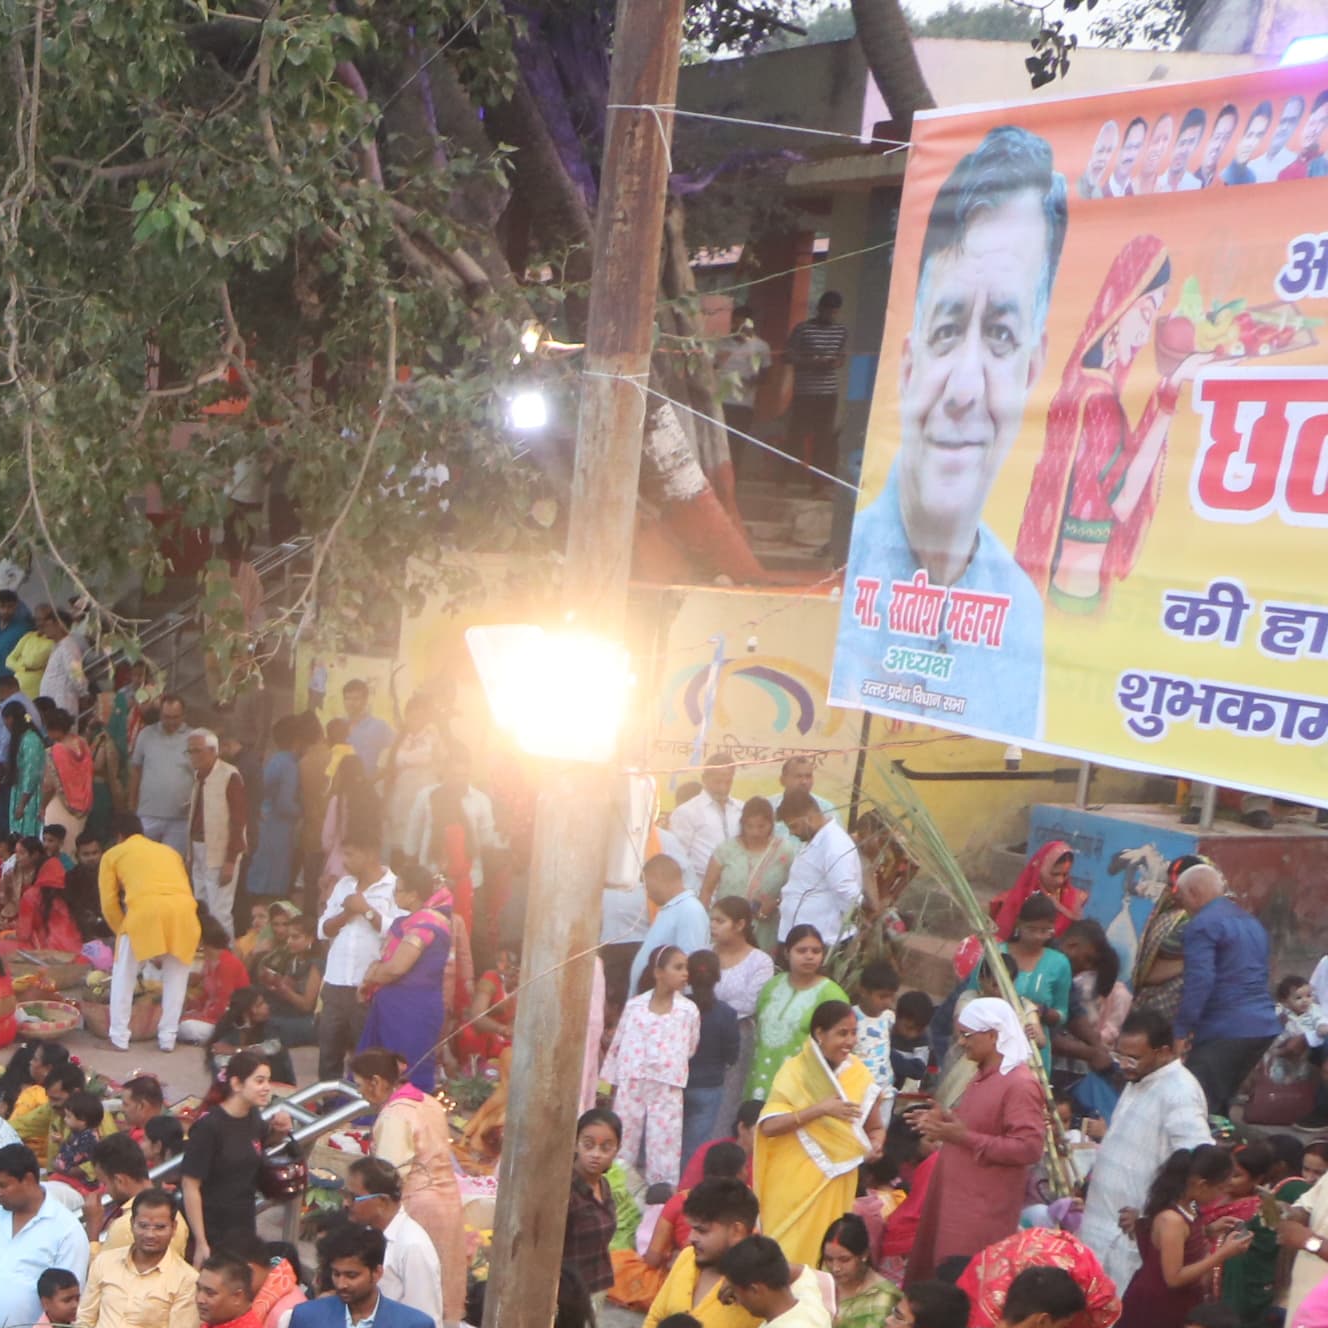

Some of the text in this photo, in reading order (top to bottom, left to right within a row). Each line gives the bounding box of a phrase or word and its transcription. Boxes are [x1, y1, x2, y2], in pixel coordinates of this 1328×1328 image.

[854, 573, 1010, 646] मा. सतीश महाना
[1164, 582, 1250, 643] की
[884, 649, 953, 679] अध्यक्ष
[862, 680, 887, 698] उत्तर
[912, 684, 941, 708] विधान
[943, 696, 965, 713] सभा
